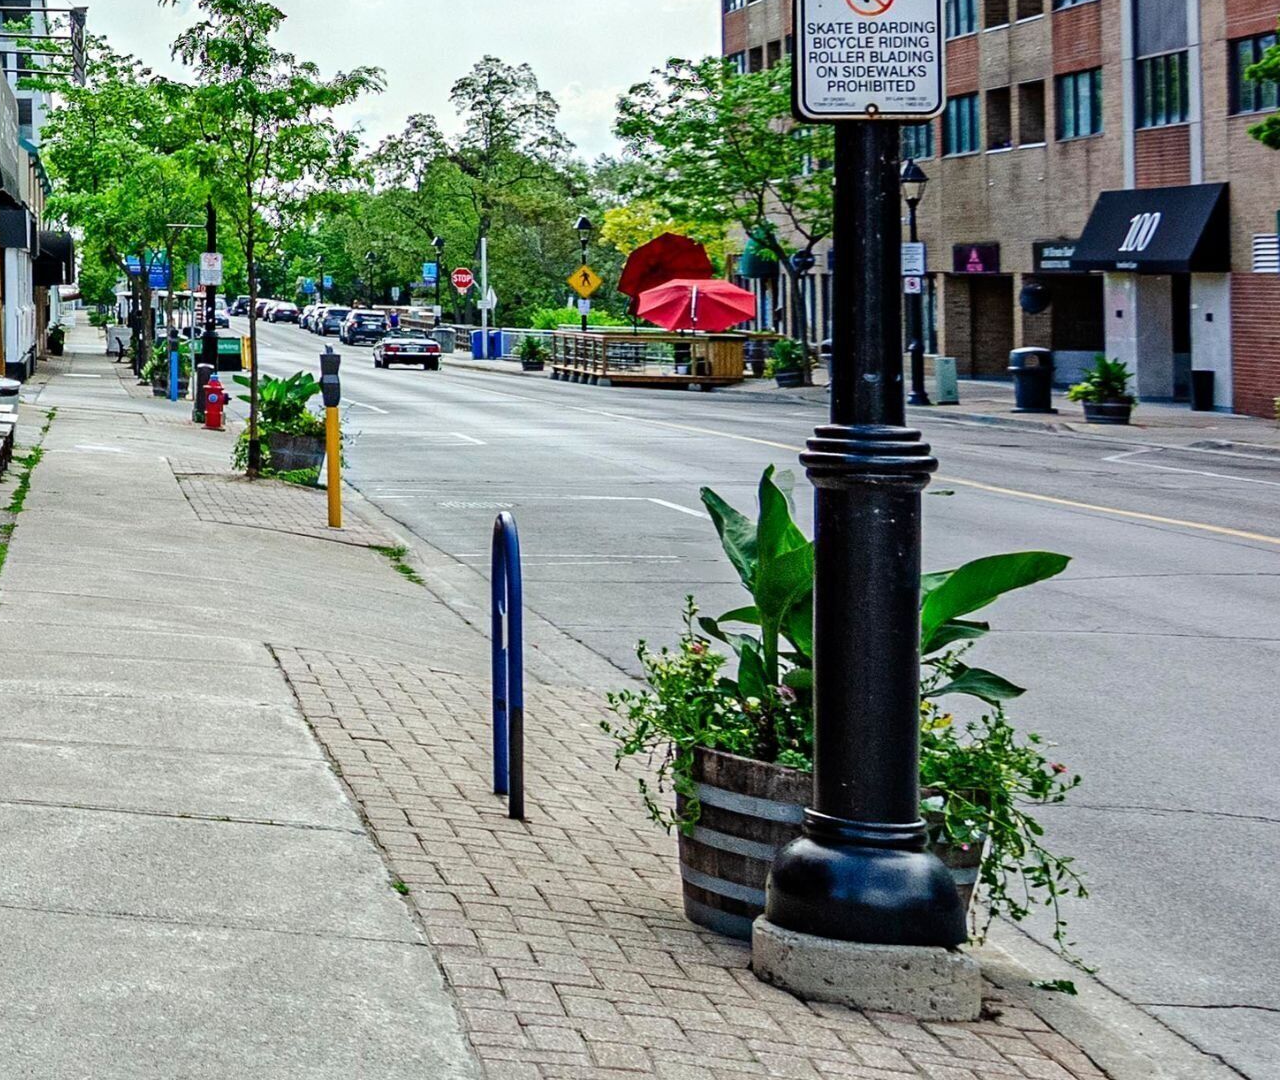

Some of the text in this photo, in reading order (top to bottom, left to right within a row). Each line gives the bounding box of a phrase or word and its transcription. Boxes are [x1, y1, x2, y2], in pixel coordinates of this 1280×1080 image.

[807, 21, 936, 35] SKATE BOARDING
[813, 36, 929, 50] BICYCLE RIDING
[808, 50, 934, 64] ROLLER BLADING
[816, 65, 927, 79] ON SIDEWALKS
[827, 79, 916, 93] PROHIBITED
[1117, 211, 1161, 252] 100
[453, 274, 472, 283] STOP
